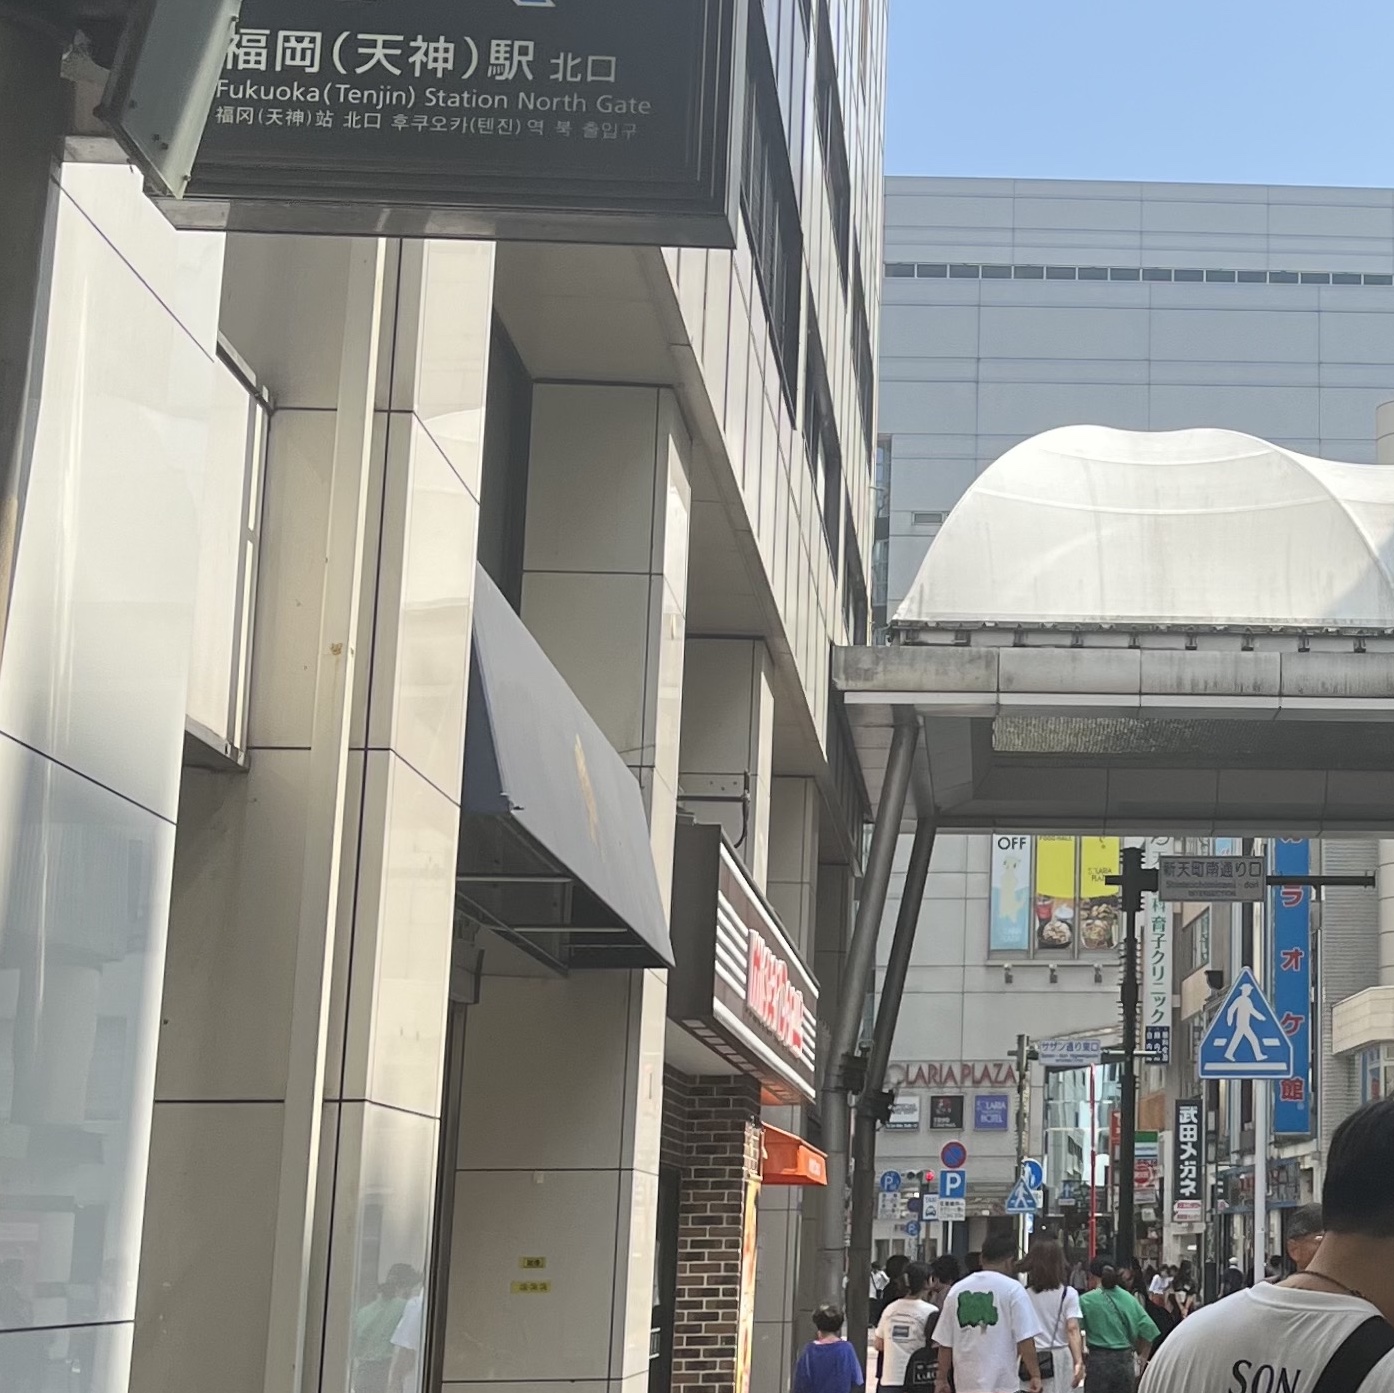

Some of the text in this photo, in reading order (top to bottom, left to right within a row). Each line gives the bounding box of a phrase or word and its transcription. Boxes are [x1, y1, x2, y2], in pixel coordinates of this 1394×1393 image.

[226, 28, 617, 83] 福岡(天神)駅 北口
[216, 78, 651, 115] Fukuoka(Tenjin) Station North Gate
[343, 111, 382, 129] 北口
[391, 112, 521, 136] 후쿠오카(텐진)
[527, 119, 545, 136] 역
[555, 120, 572, 137] 북
[997, 836, 1027, 850] OFF
[961, 1063, 1016, 1086] PLAZA
[1178, 1105, 1199, 1197] 武田メガネ
